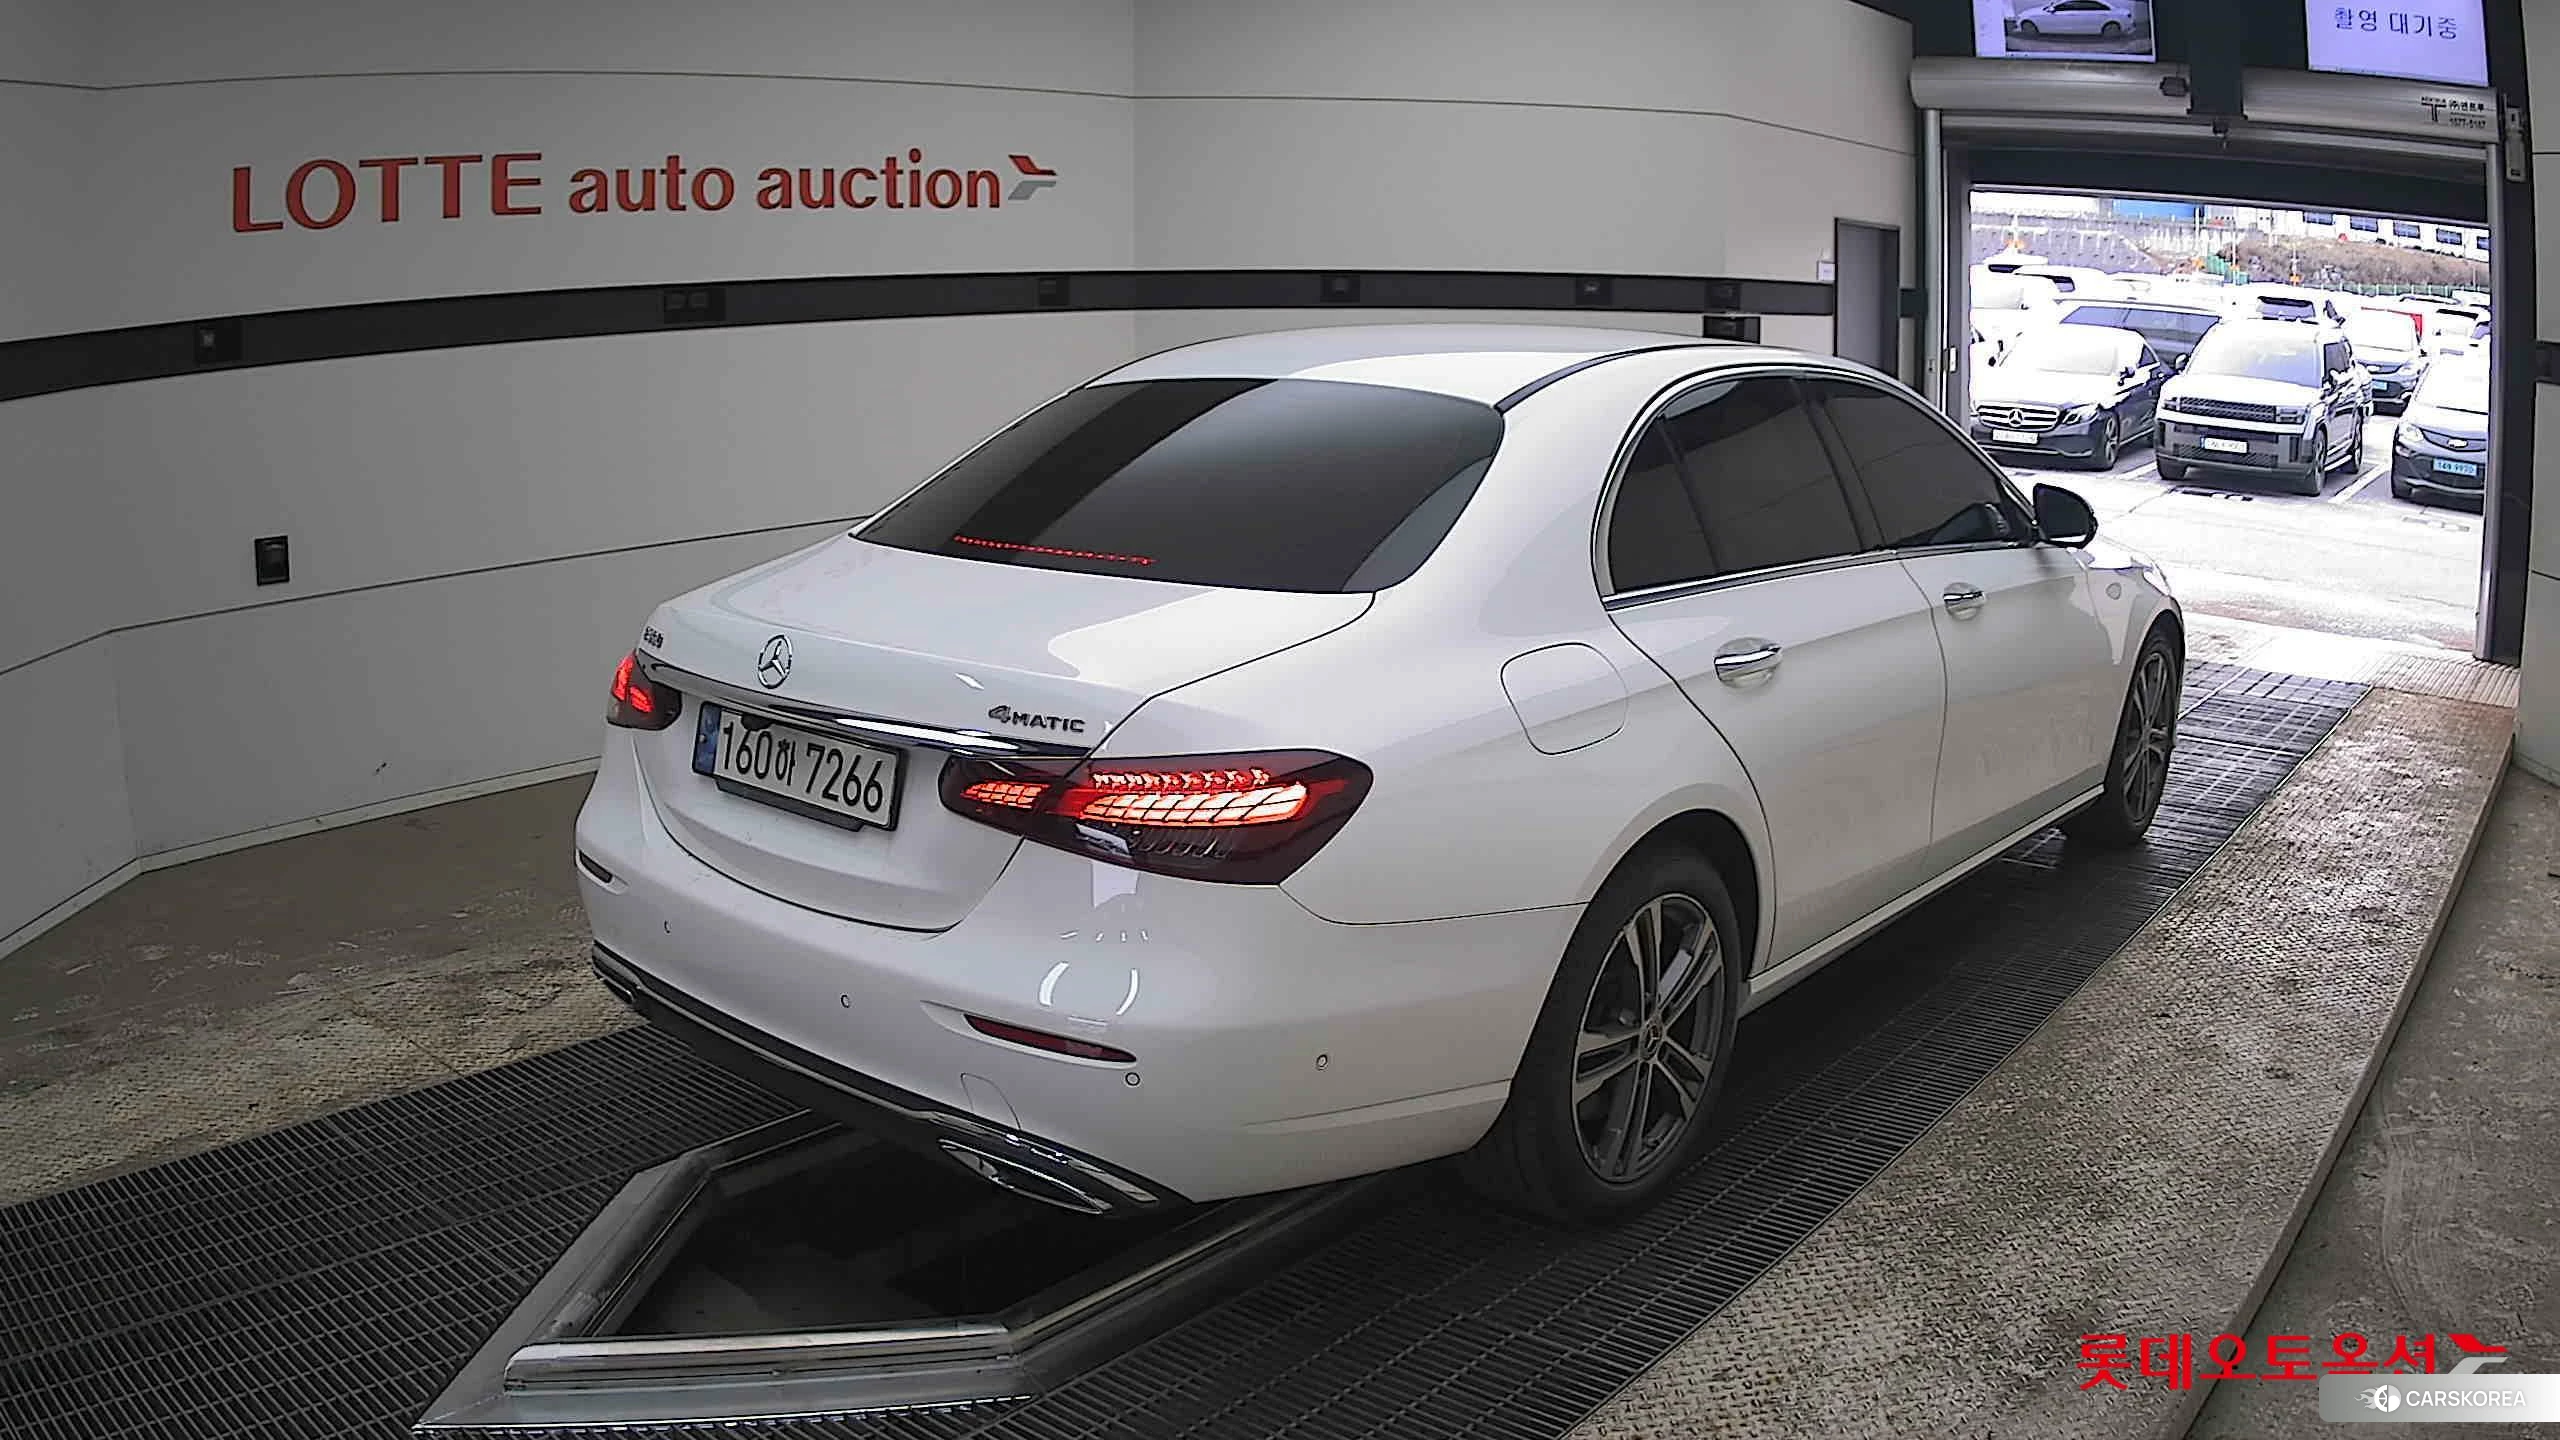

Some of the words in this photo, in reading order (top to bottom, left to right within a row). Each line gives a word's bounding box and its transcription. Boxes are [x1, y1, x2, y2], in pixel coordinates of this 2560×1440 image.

[2389, 13, 2457, 40] 대기중
[233, 152, 542, 233] LOTTE
[569, 154, 735, 213] auto
[757, 147, 1000, 209] auction
[988, 704, 1085, 733] 4MATIC
[723, 721, 796, 786] 160하
[805, 742, 884, 813] 7266
